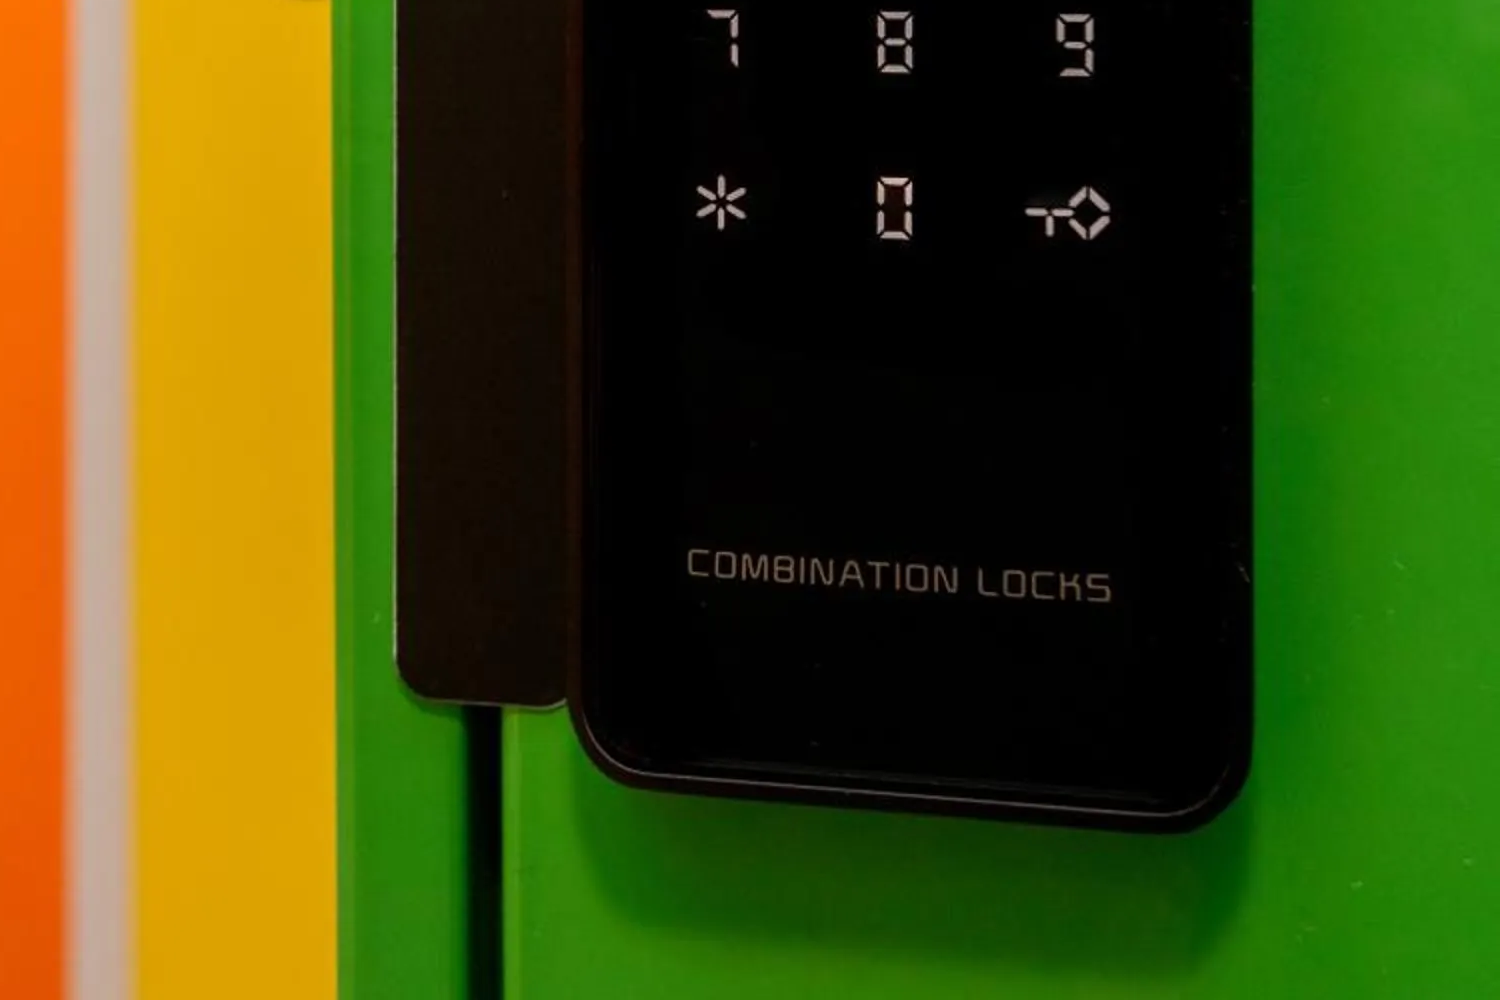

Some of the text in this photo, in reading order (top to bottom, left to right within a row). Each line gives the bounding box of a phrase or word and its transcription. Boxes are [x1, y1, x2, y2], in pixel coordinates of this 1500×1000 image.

[706, 8, 1095, 78] 7 8 9
[876, 176, 914, 242] 0
[687, 548, 1113, 603] COMBINATION LOCKS
